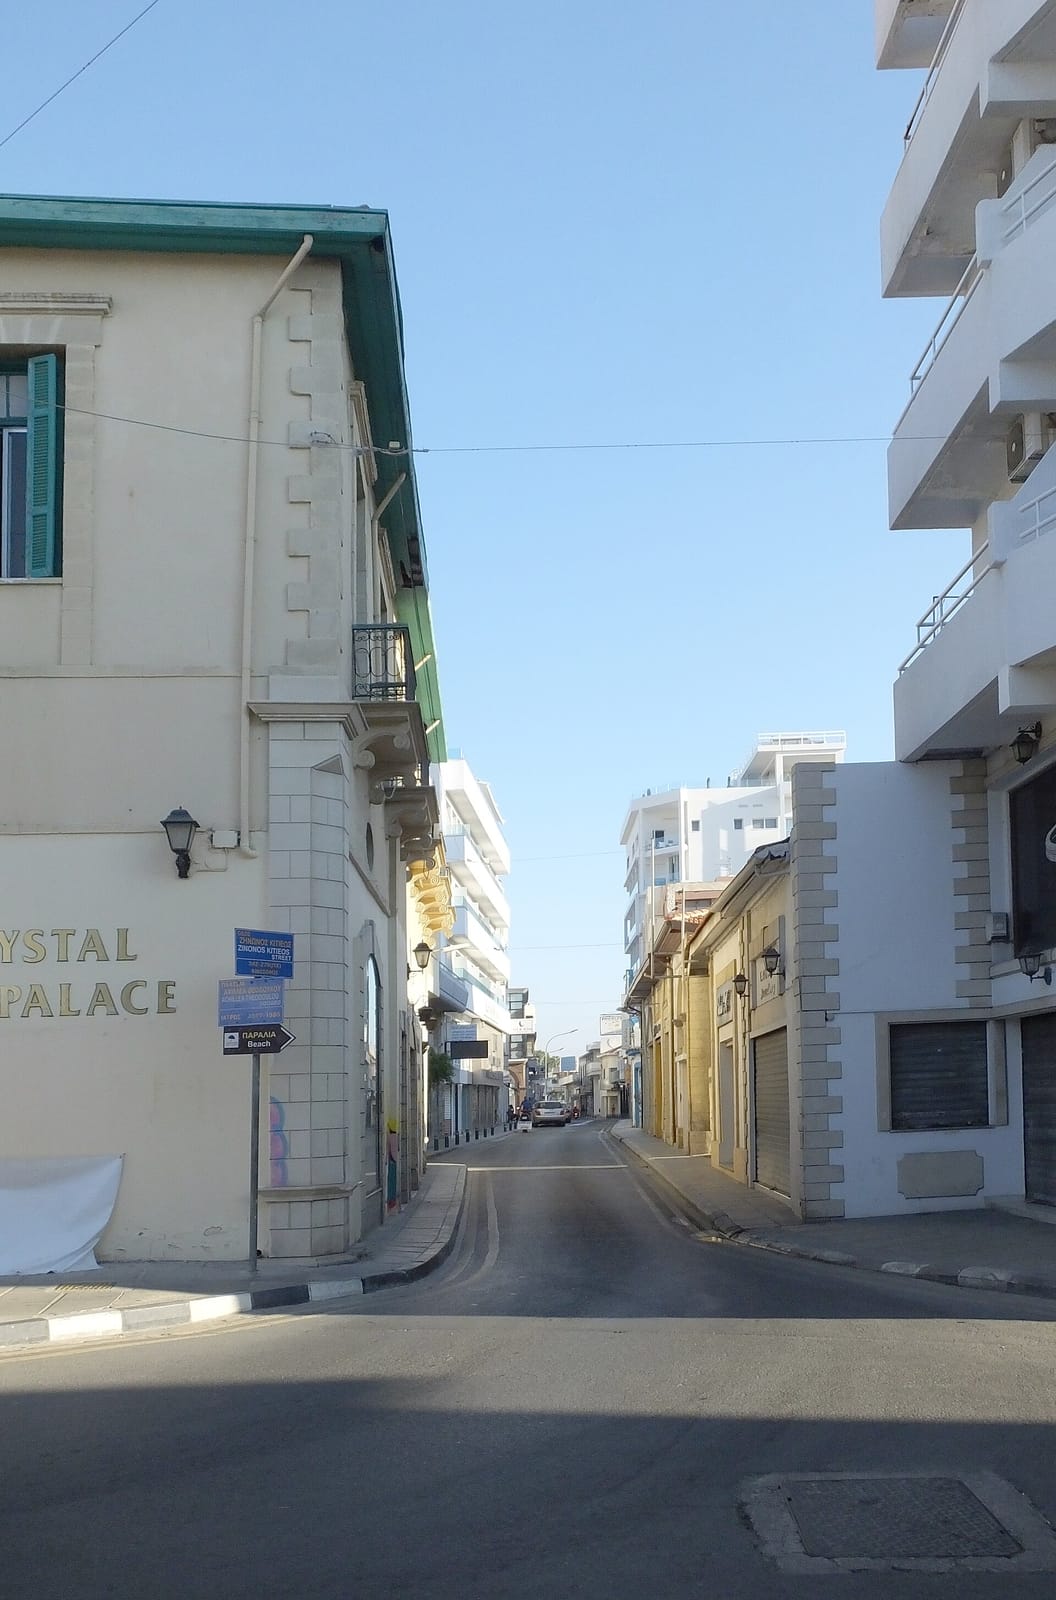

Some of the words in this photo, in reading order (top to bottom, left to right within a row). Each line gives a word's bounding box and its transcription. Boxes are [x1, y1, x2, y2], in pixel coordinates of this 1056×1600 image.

[237, 945, 266, 954] ZINONOS
[266, 947, 290, 955] KITIEOS
[0, 980, 177, 1018] PALACE
[242, 1031, 276, 1039] ΠΑΡΑΛΙΑ
[247, 1040, 271, 1048] Beach
